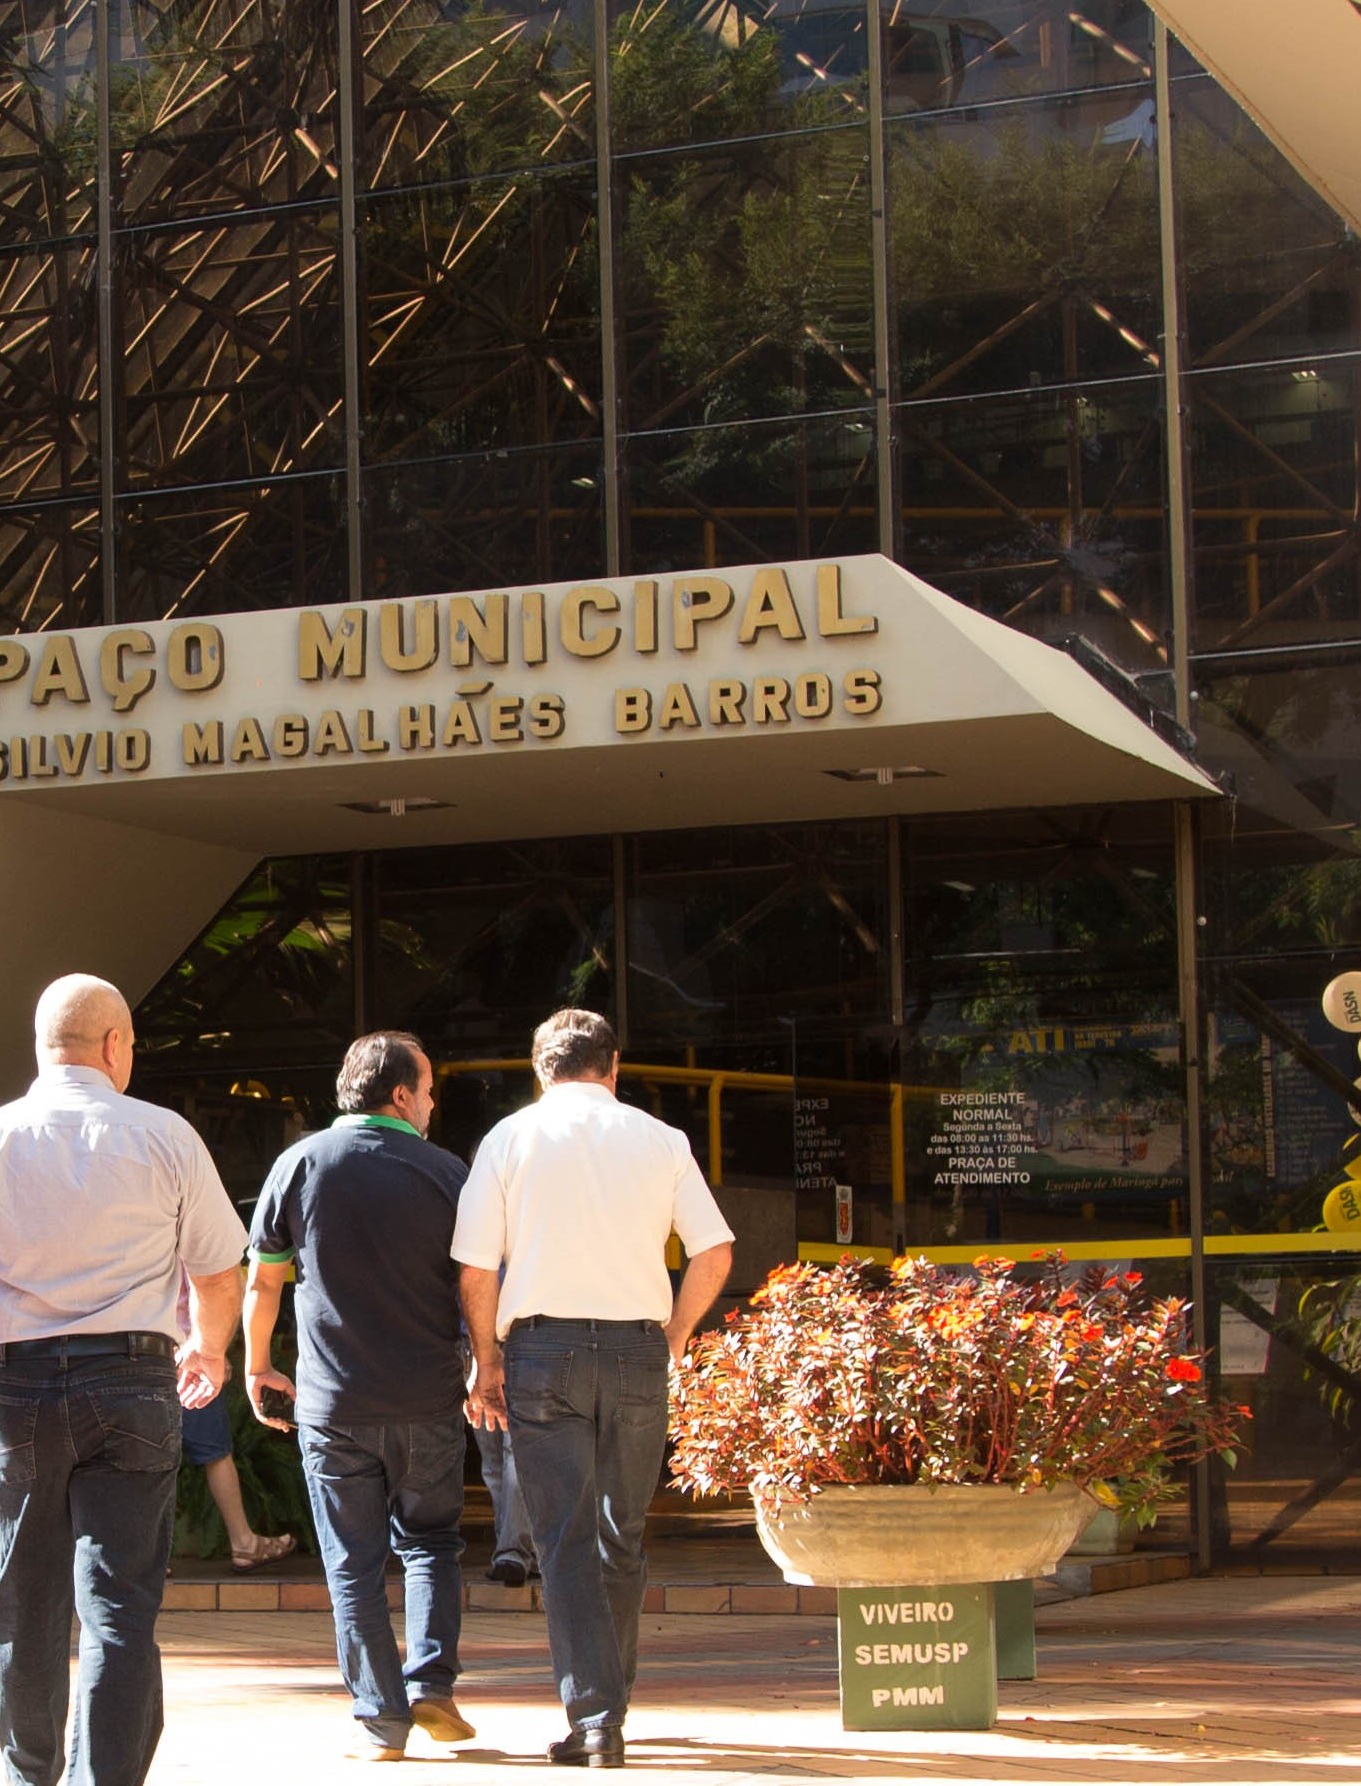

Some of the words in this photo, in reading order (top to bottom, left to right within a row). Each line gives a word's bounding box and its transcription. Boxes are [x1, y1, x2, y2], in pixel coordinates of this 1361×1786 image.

[298, 563, 879, 681] MUNICIPAL
[182, 681, 567, 765] MAGALHÃES
[613, 668, 883, 734] BARROS
[1008, 1028, 1065, 1054] ATI
[940, 1092, 1026, 1106] EXPEDIENTE
[953, 1109, 1013, 1121] NORMAL
[995, 1122, 1022, 1131] Sexta
[931, 1134, 948, 1143] das
[950, 1134, 976, 1143] 08:00
[993, 1134, 1018, 1143] 11:30
[934, 1146, 952, 1155] das
[955, 1146, 981, 1154] 13:30
[996, 1145, 1022, 1154] 17:00
[949, 1157, 995, 1171] PRAÇA
[998, 1157, 1016, 1169] DE
[934, 1172, 1031, 1185] ATENDIMENTO
[859, 1601, 954, 1626] VIVEIRO
[855, 1642, 969, 1665] SEMUSP
[872, 1684, 944, 1708] PMM
